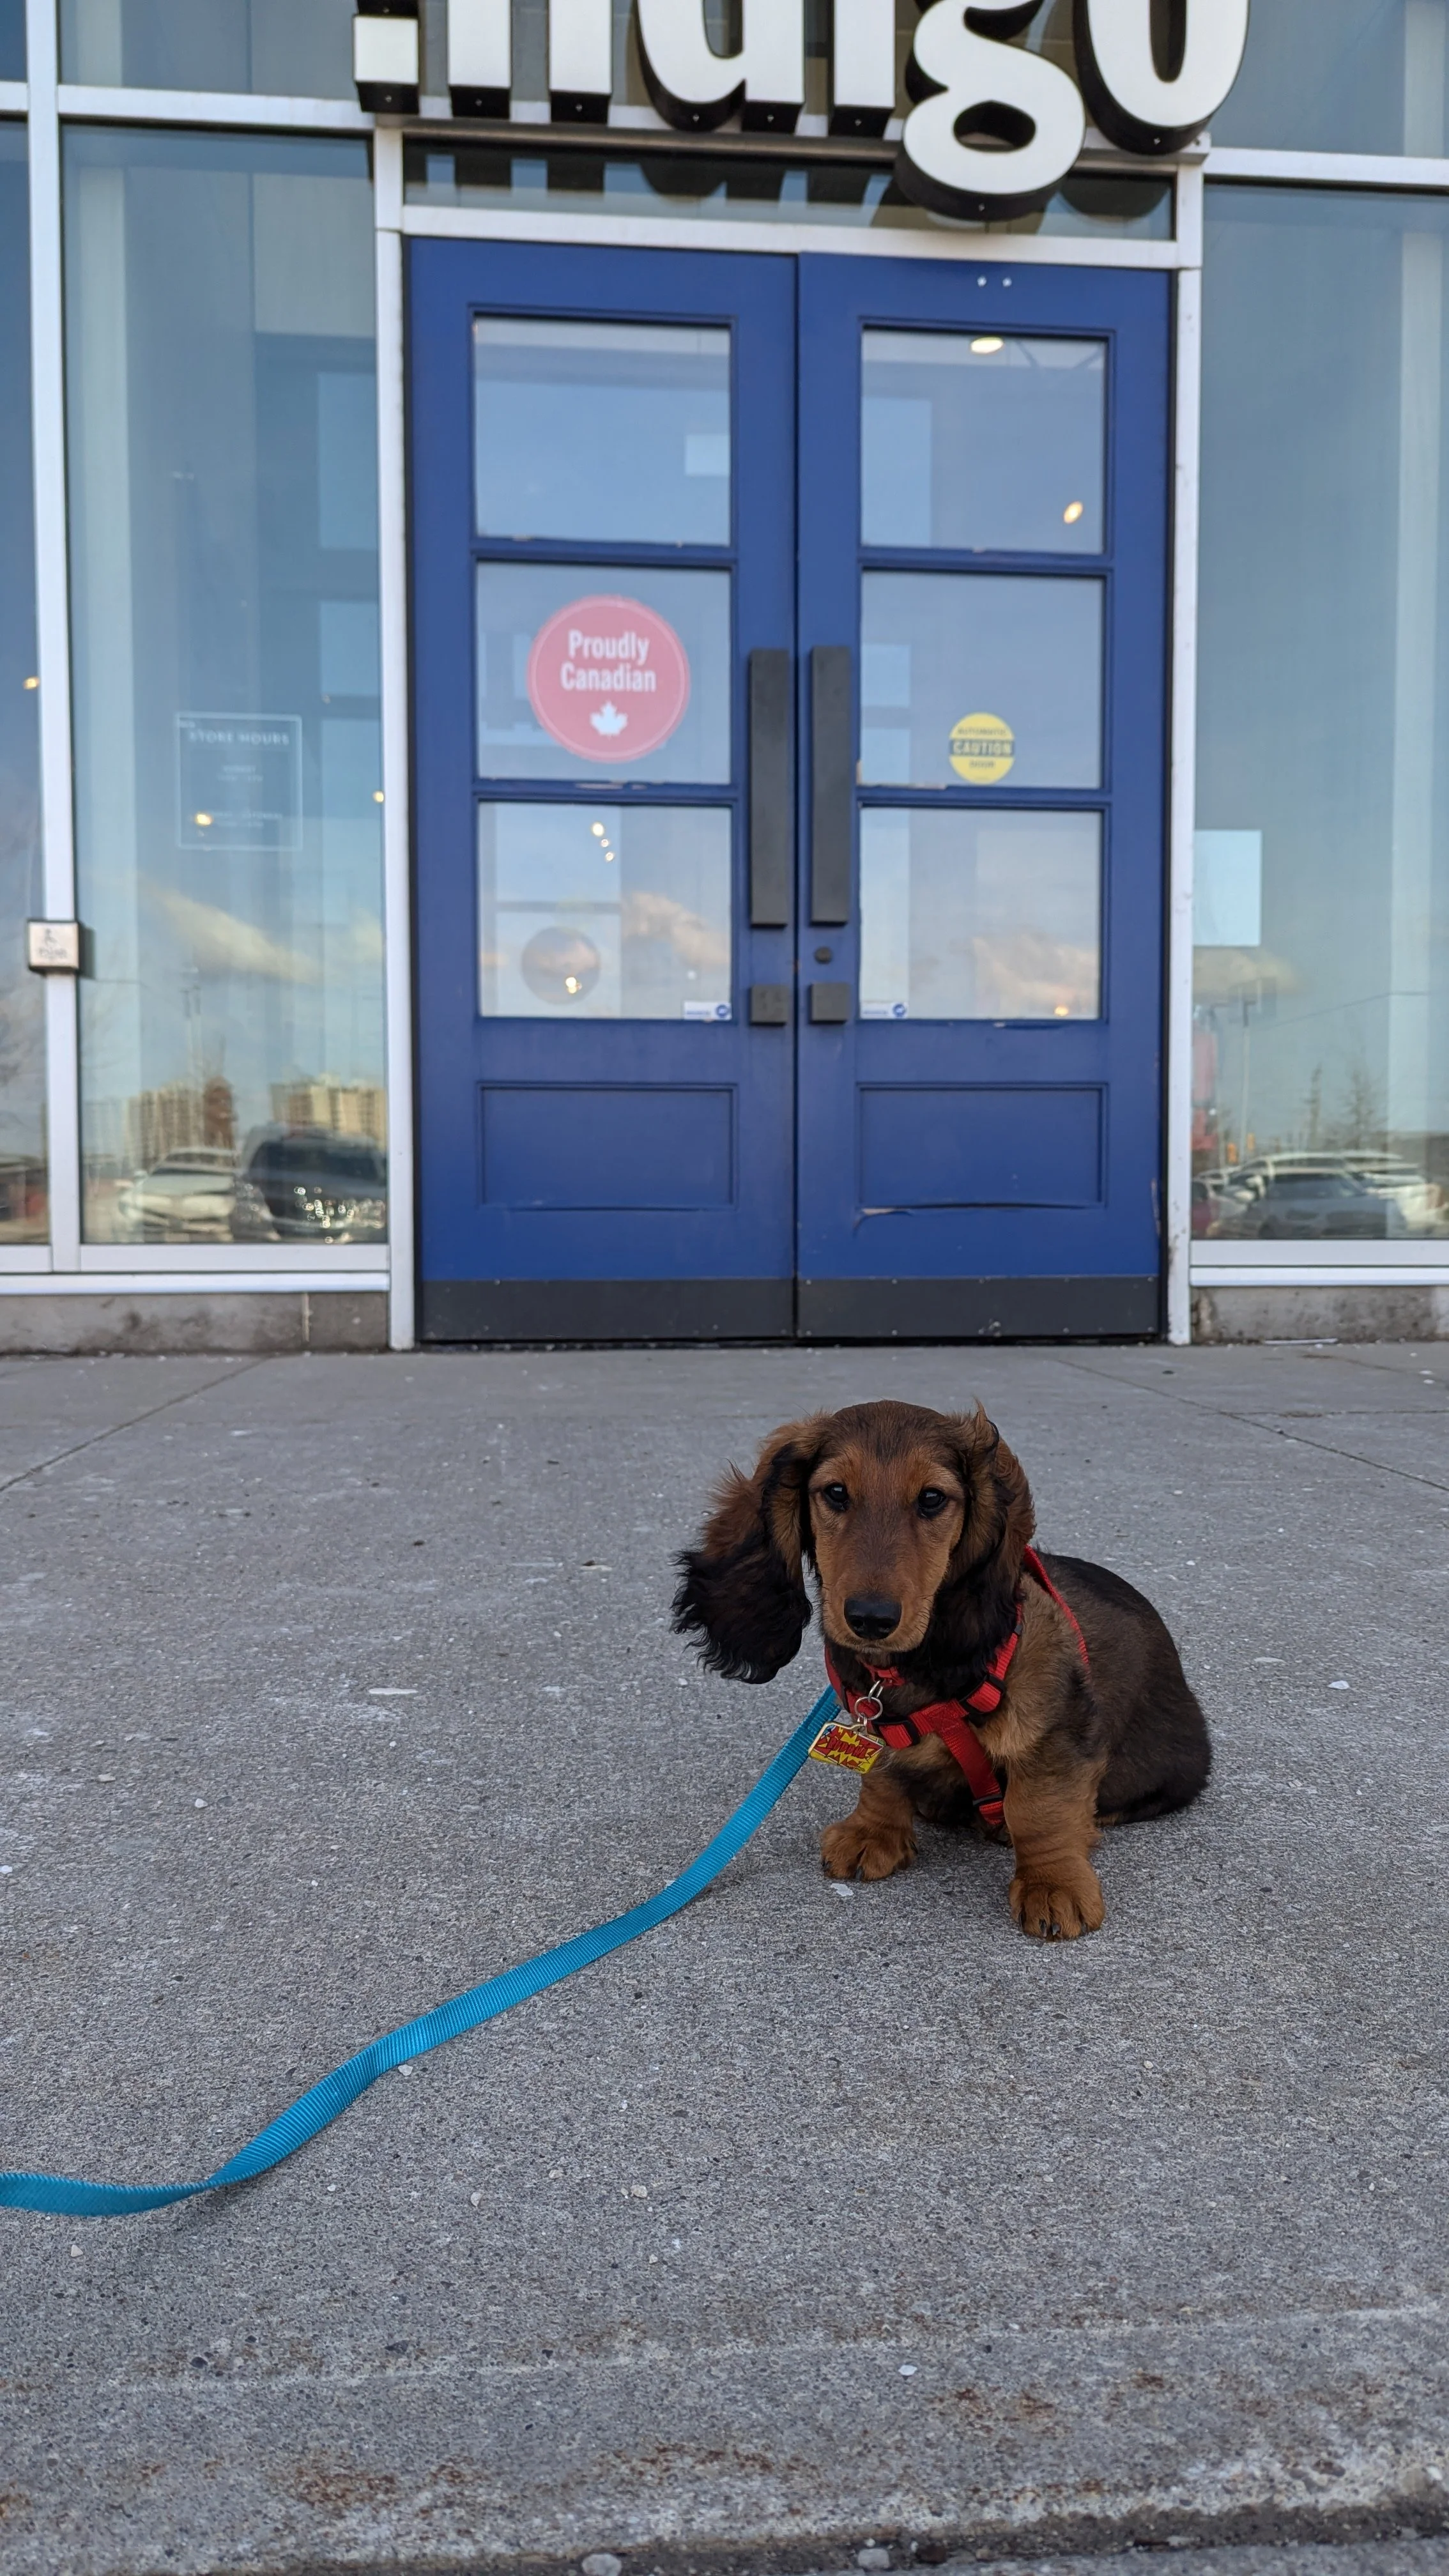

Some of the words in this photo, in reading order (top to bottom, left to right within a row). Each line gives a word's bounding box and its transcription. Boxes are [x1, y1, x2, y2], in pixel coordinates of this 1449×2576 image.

[568, 629, 650, 666] Proudly
[560, 661, 657, 693] Canadian
[952, 740, 1012, 755] CAUTION
